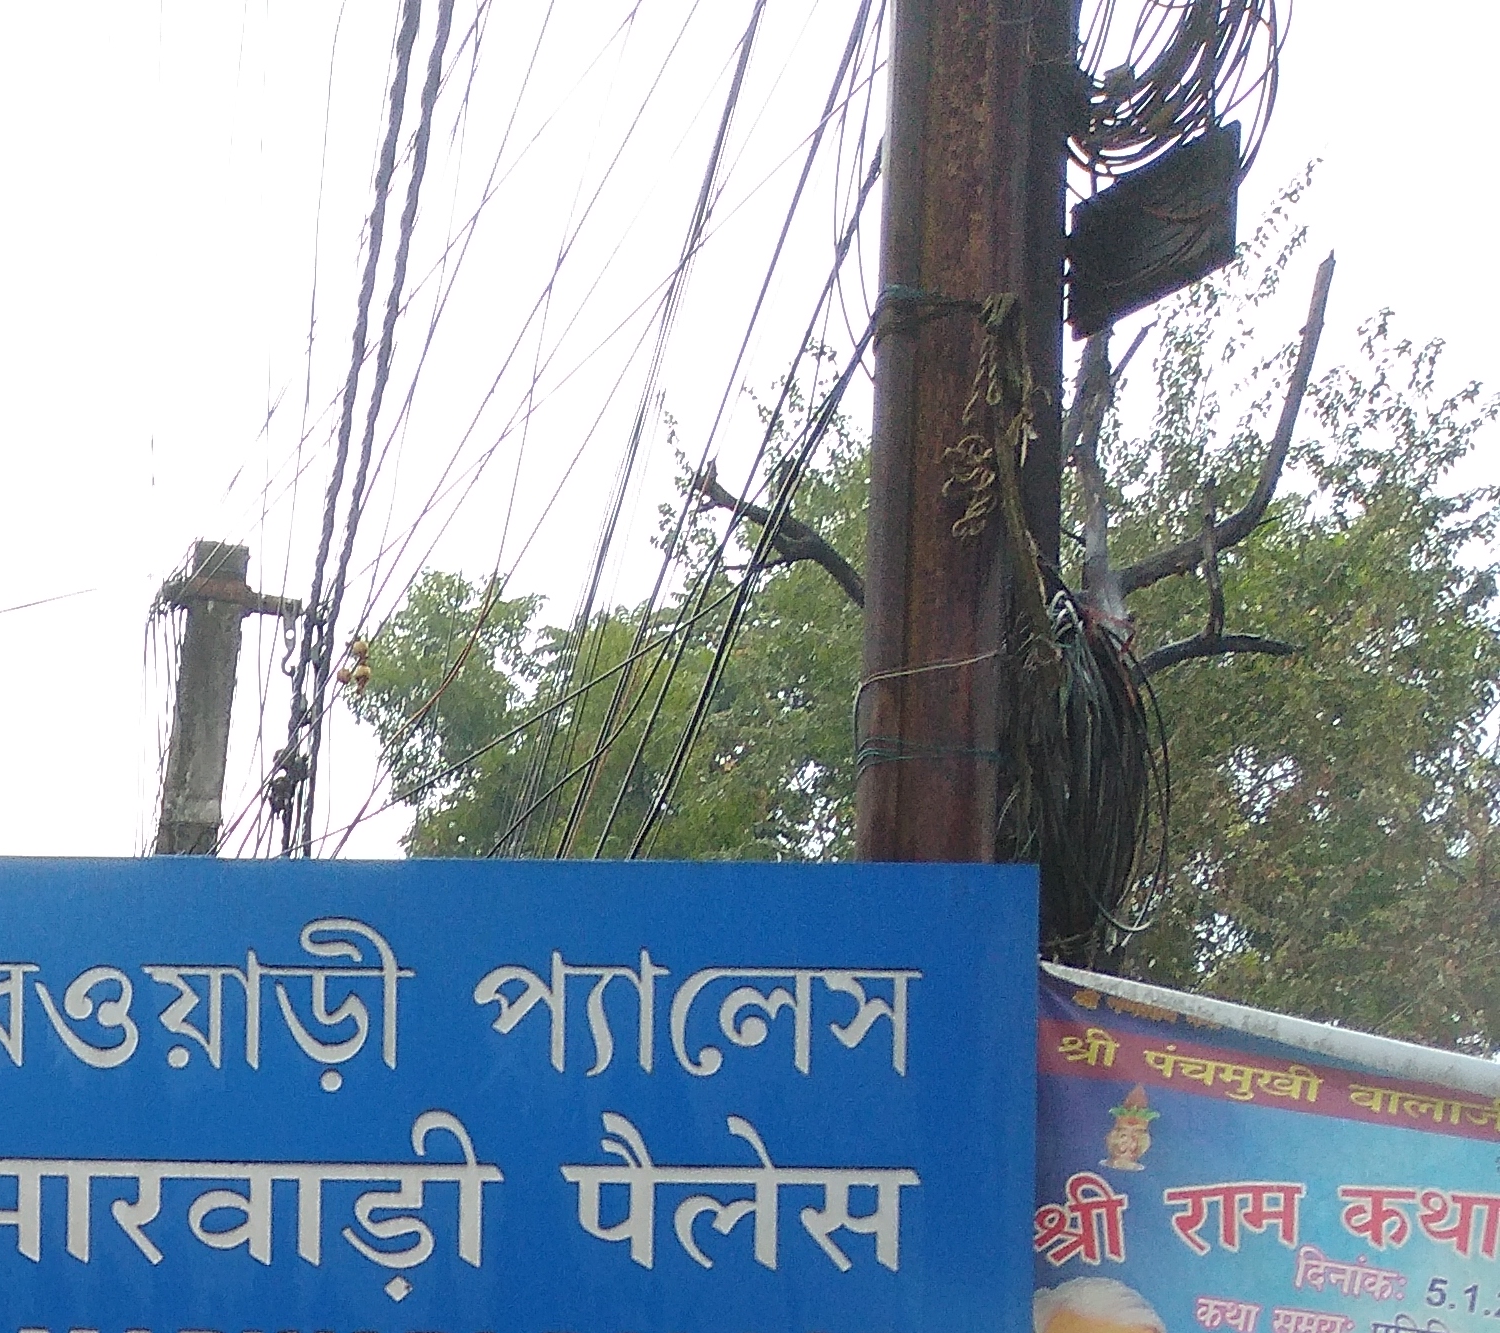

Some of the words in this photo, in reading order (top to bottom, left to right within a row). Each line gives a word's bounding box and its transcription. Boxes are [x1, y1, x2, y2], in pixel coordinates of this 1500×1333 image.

[474, 948, 922, 1077] প্যালেস
[1058, 1028, 1120, 1067] श्री
[1143, 1044, 1324, 1102] पंचमुखी
[561, 1111, 921, 1273] पैलेस
[1034, 1172, 1127, 1266] श्री
[1164, 1182, 1306, 1256] राम
[1338, 1184, 1500, 1258] कथा
[1426, 1276, 1500, 1318] 5.1.
